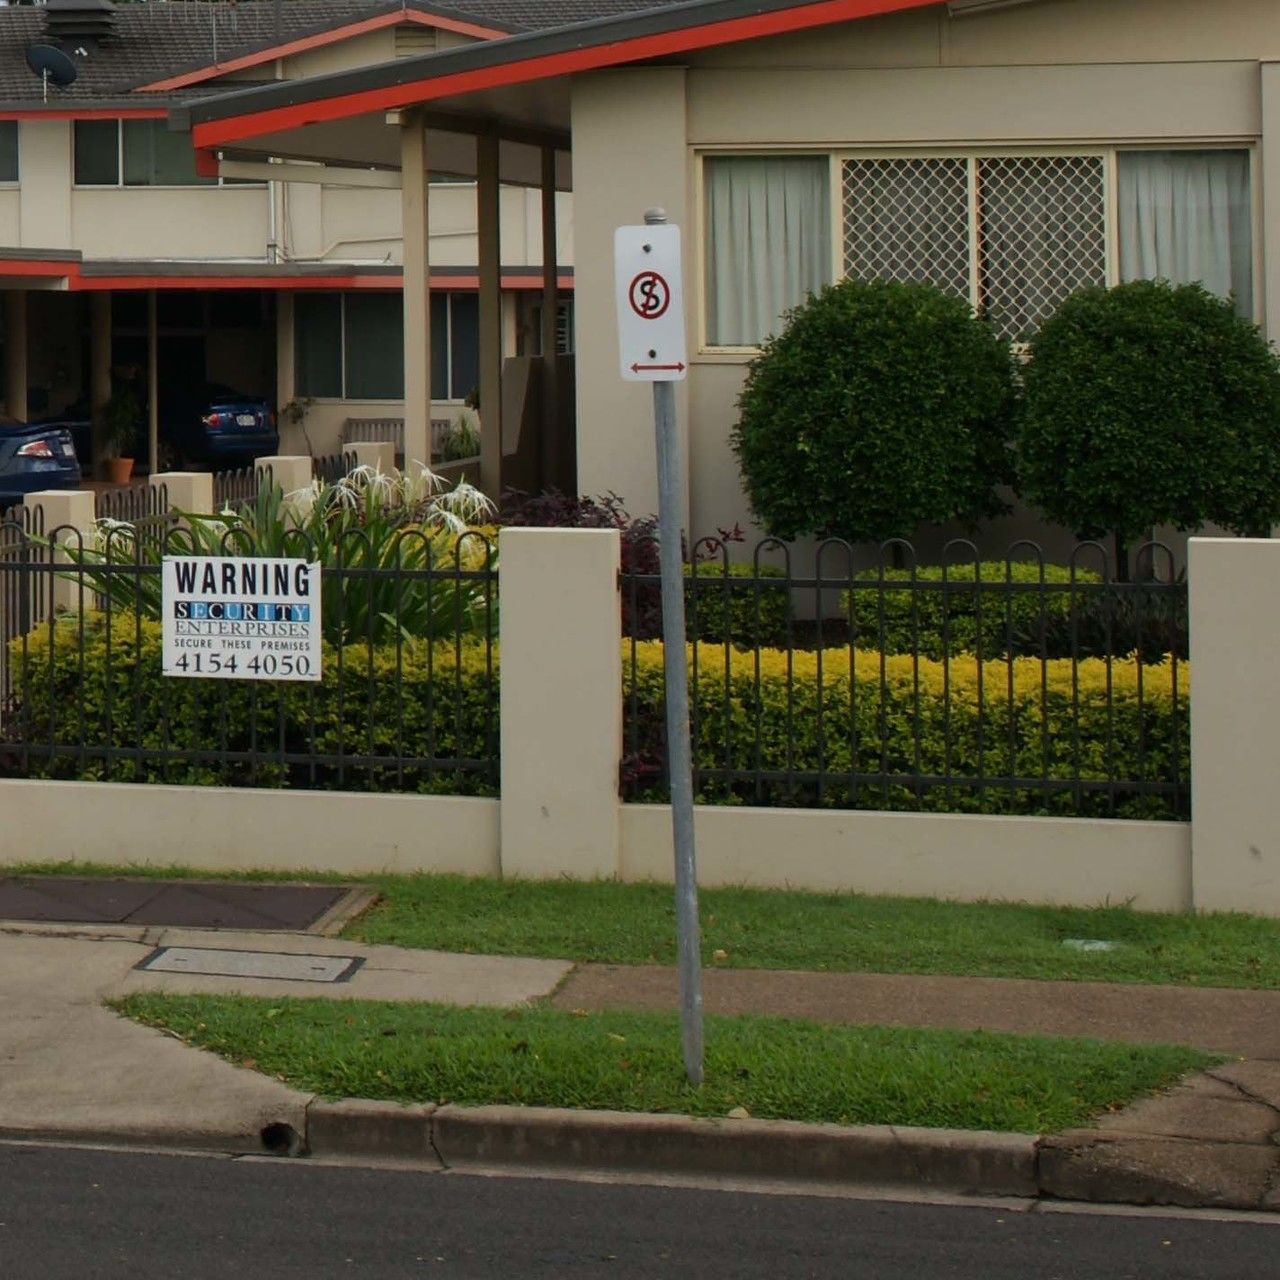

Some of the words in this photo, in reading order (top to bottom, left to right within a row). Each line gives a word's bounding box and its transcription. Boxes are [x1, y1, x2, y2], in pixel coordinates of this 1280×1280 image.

[175, 561, 309, 597] WARNING
[175, 602, 309, 621] SECURITY
[175, 621, 309, 636] ENTERPRISES
[174, 638, 212, 649] SECURE
[222, 639, 252, 650] THESE
[261, 640, 310, 651] PREMISES
[175, 652, 238, 673] 4154
[247, 653, 310, 676] 4050
